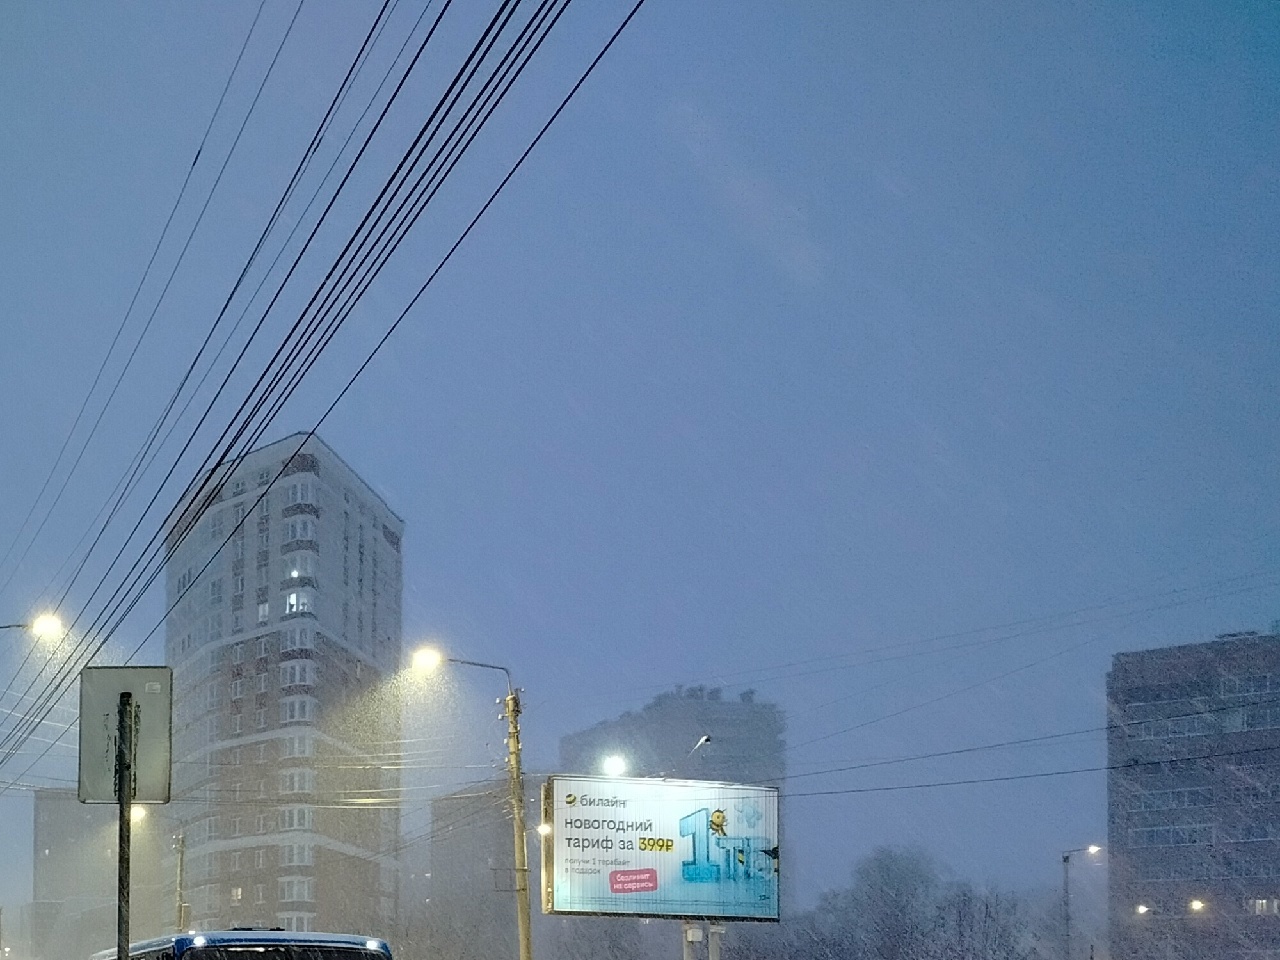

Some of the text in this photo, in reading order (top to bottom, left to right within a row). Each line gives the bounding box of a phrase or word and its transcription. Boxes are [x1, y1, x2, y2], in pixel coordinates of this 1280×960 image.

[579, 794, 628, 808] билайн
[564, 818, 653, 834] новогодний
[565, 835, 614, 853] тариф
[618, 839, 635, 851] за
[598, 858, 631, 867] терабайт
